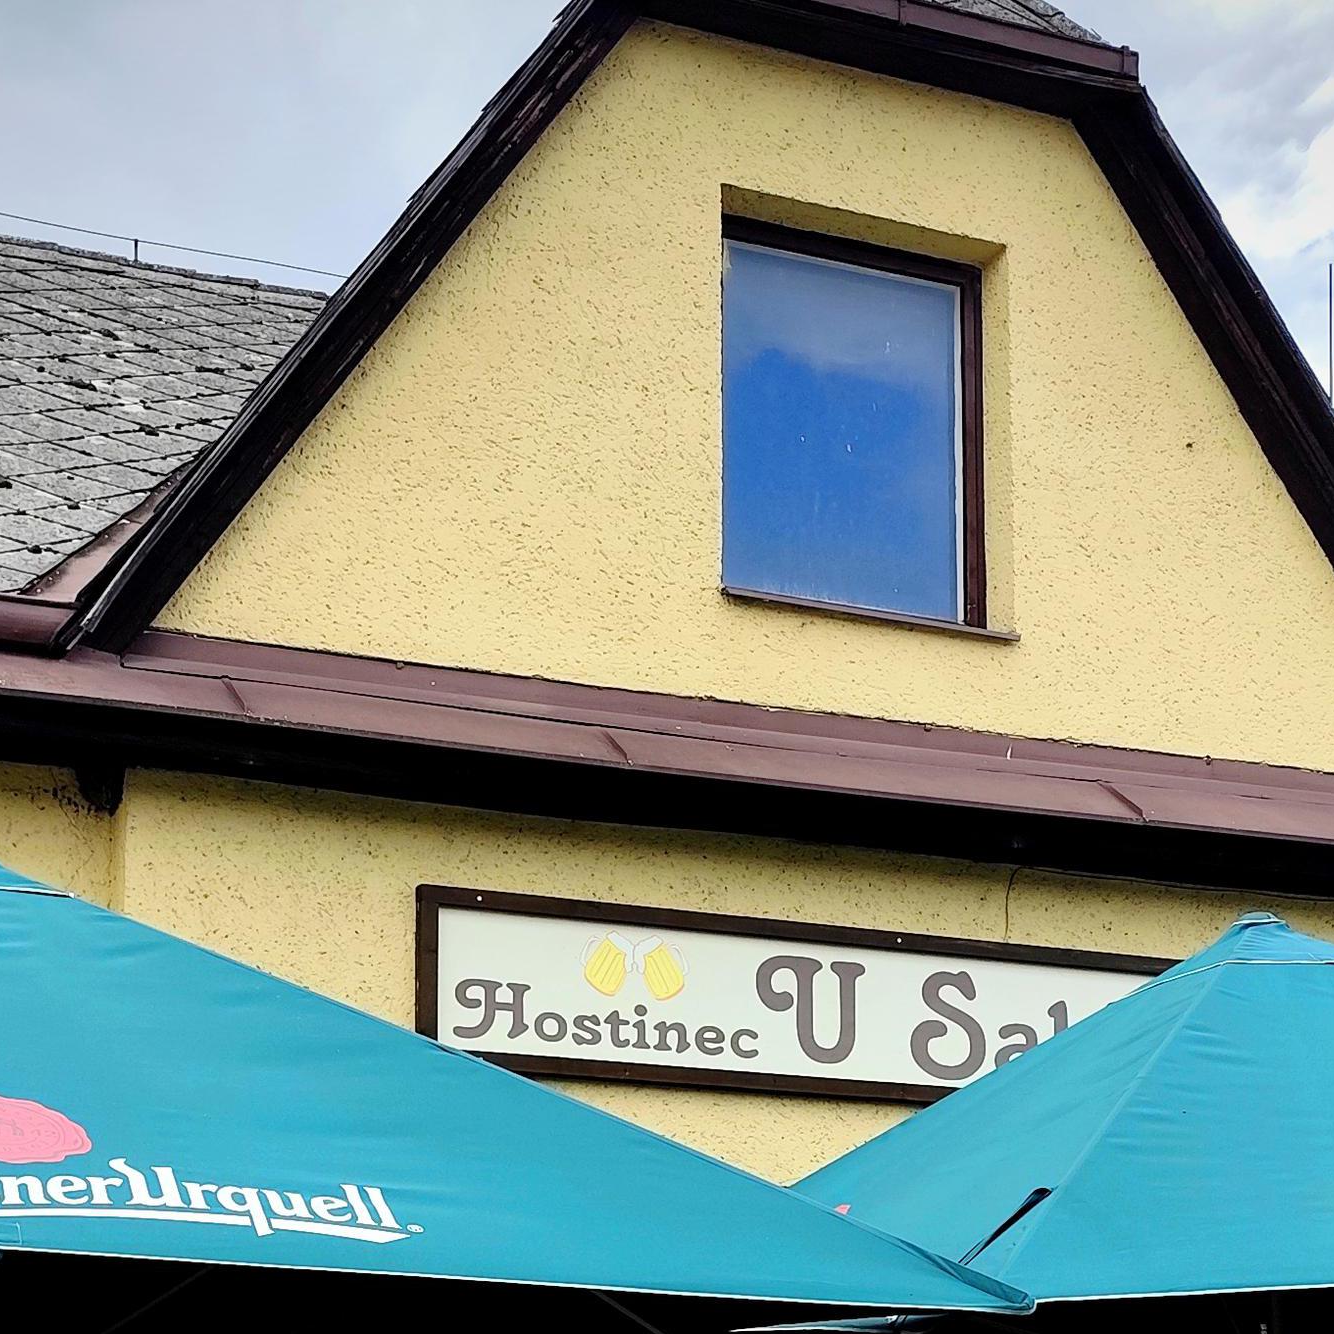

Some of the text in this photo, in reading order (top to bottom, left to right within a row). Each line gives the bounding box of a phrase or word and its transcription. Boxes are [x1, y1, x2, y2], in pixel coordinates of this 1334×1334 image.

[452, 978, 759, 1060] Hostinec
[755, 955, 866, 1064] U
[109, 1157, 408, 1238] Urquell
